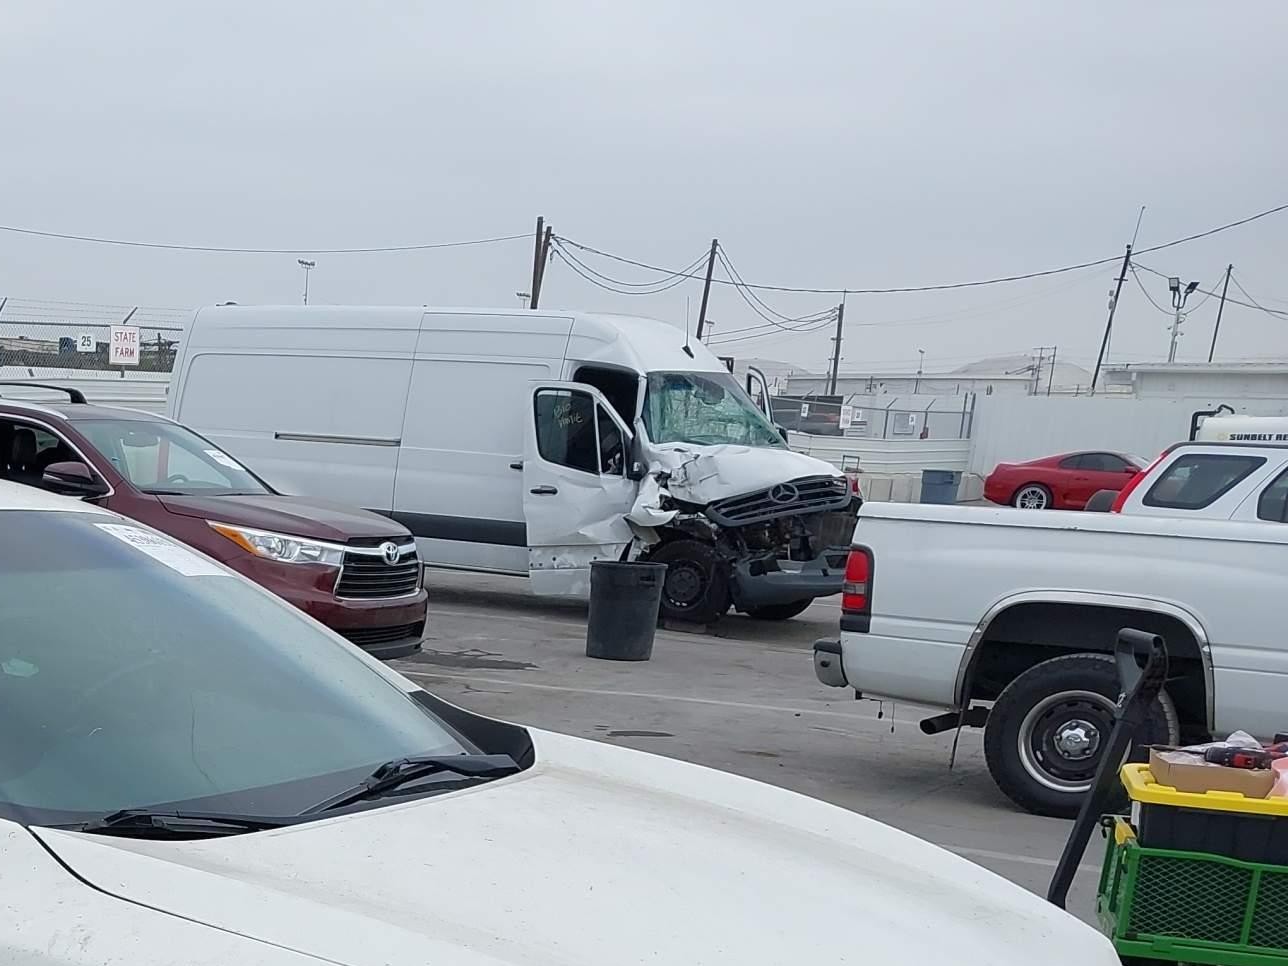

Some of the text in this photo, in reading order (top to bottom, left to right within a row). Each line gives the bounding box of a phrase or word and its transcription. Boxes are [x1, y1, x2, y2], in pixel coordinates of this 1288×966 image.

[81, 335, 92, 347] 25
[114, 331, 136, 343] STATE
[114, 346, 135, 358] FARM
[1229, 433, 1274, 441] SUNBELT
